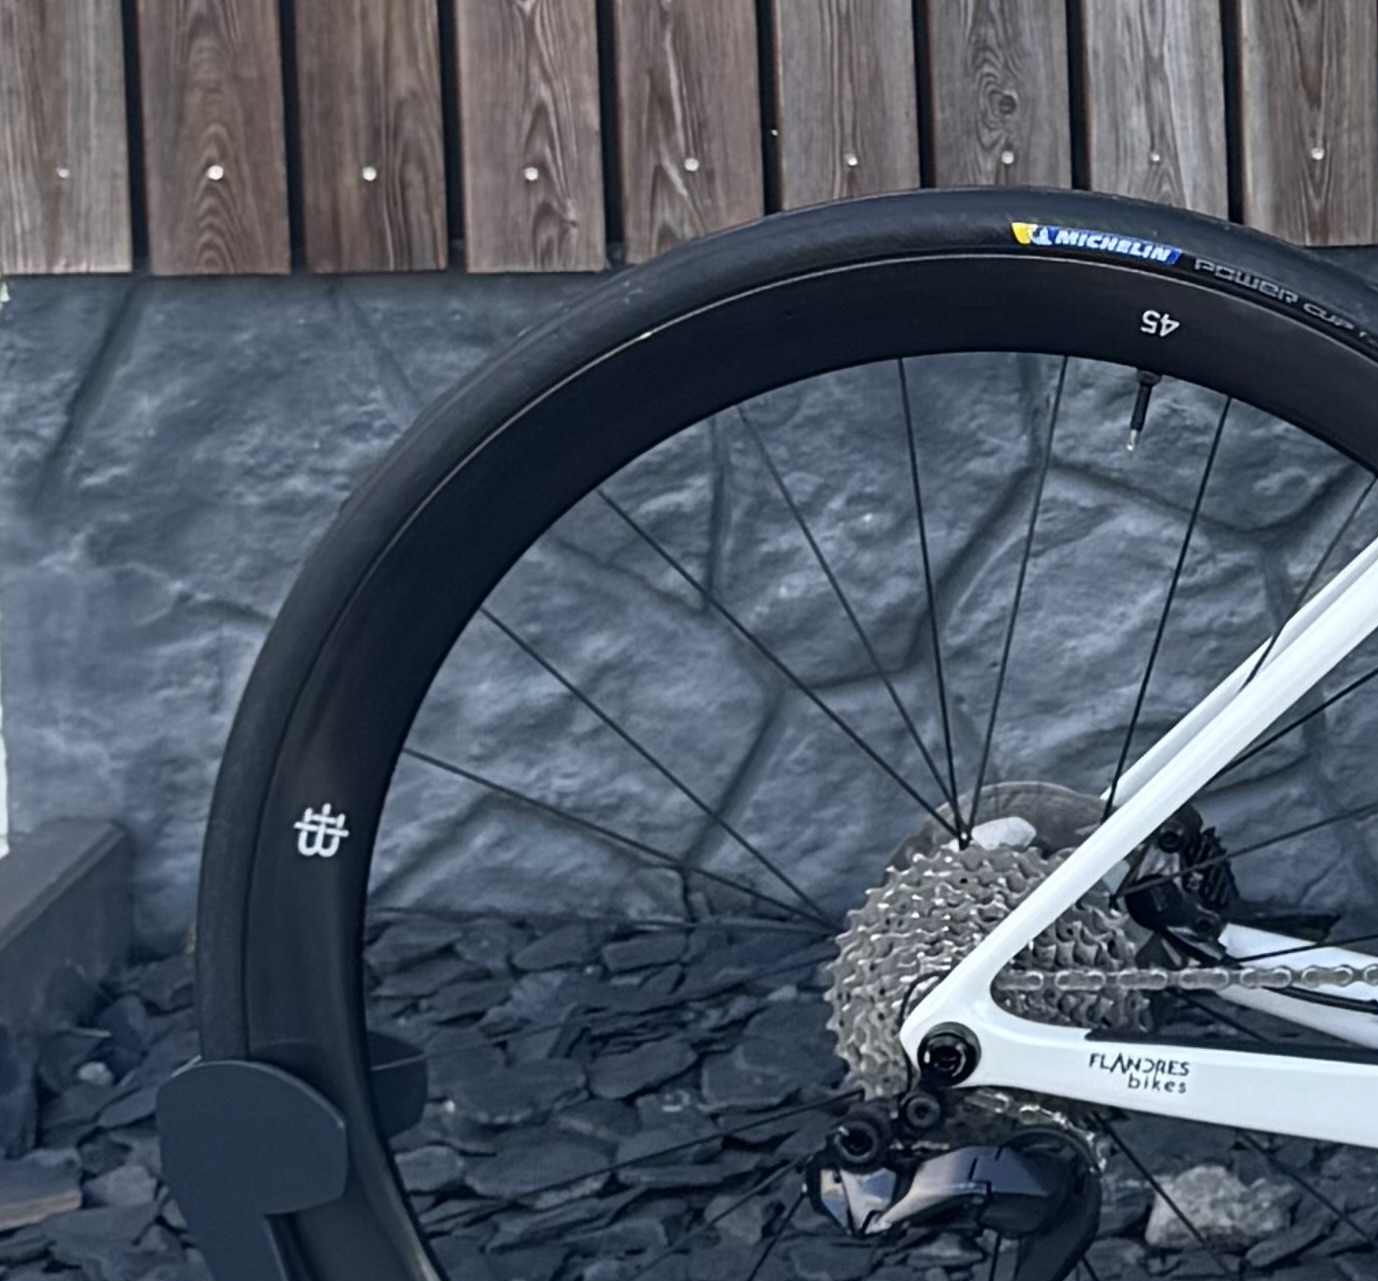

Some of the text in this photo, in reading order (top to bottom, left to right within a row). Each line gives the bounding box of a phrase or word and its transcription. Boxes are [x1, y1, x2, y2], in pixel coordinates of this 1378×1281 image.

[1054, 228, 1170, 264] MICHELIN
[1194, 258, 1300, 305] POWER
[1140, 308, 1180, 338] 45
[1088, 1051, 1191, 1077] FLANDRES
[1127, 1072, 1187, 1094] bikes
